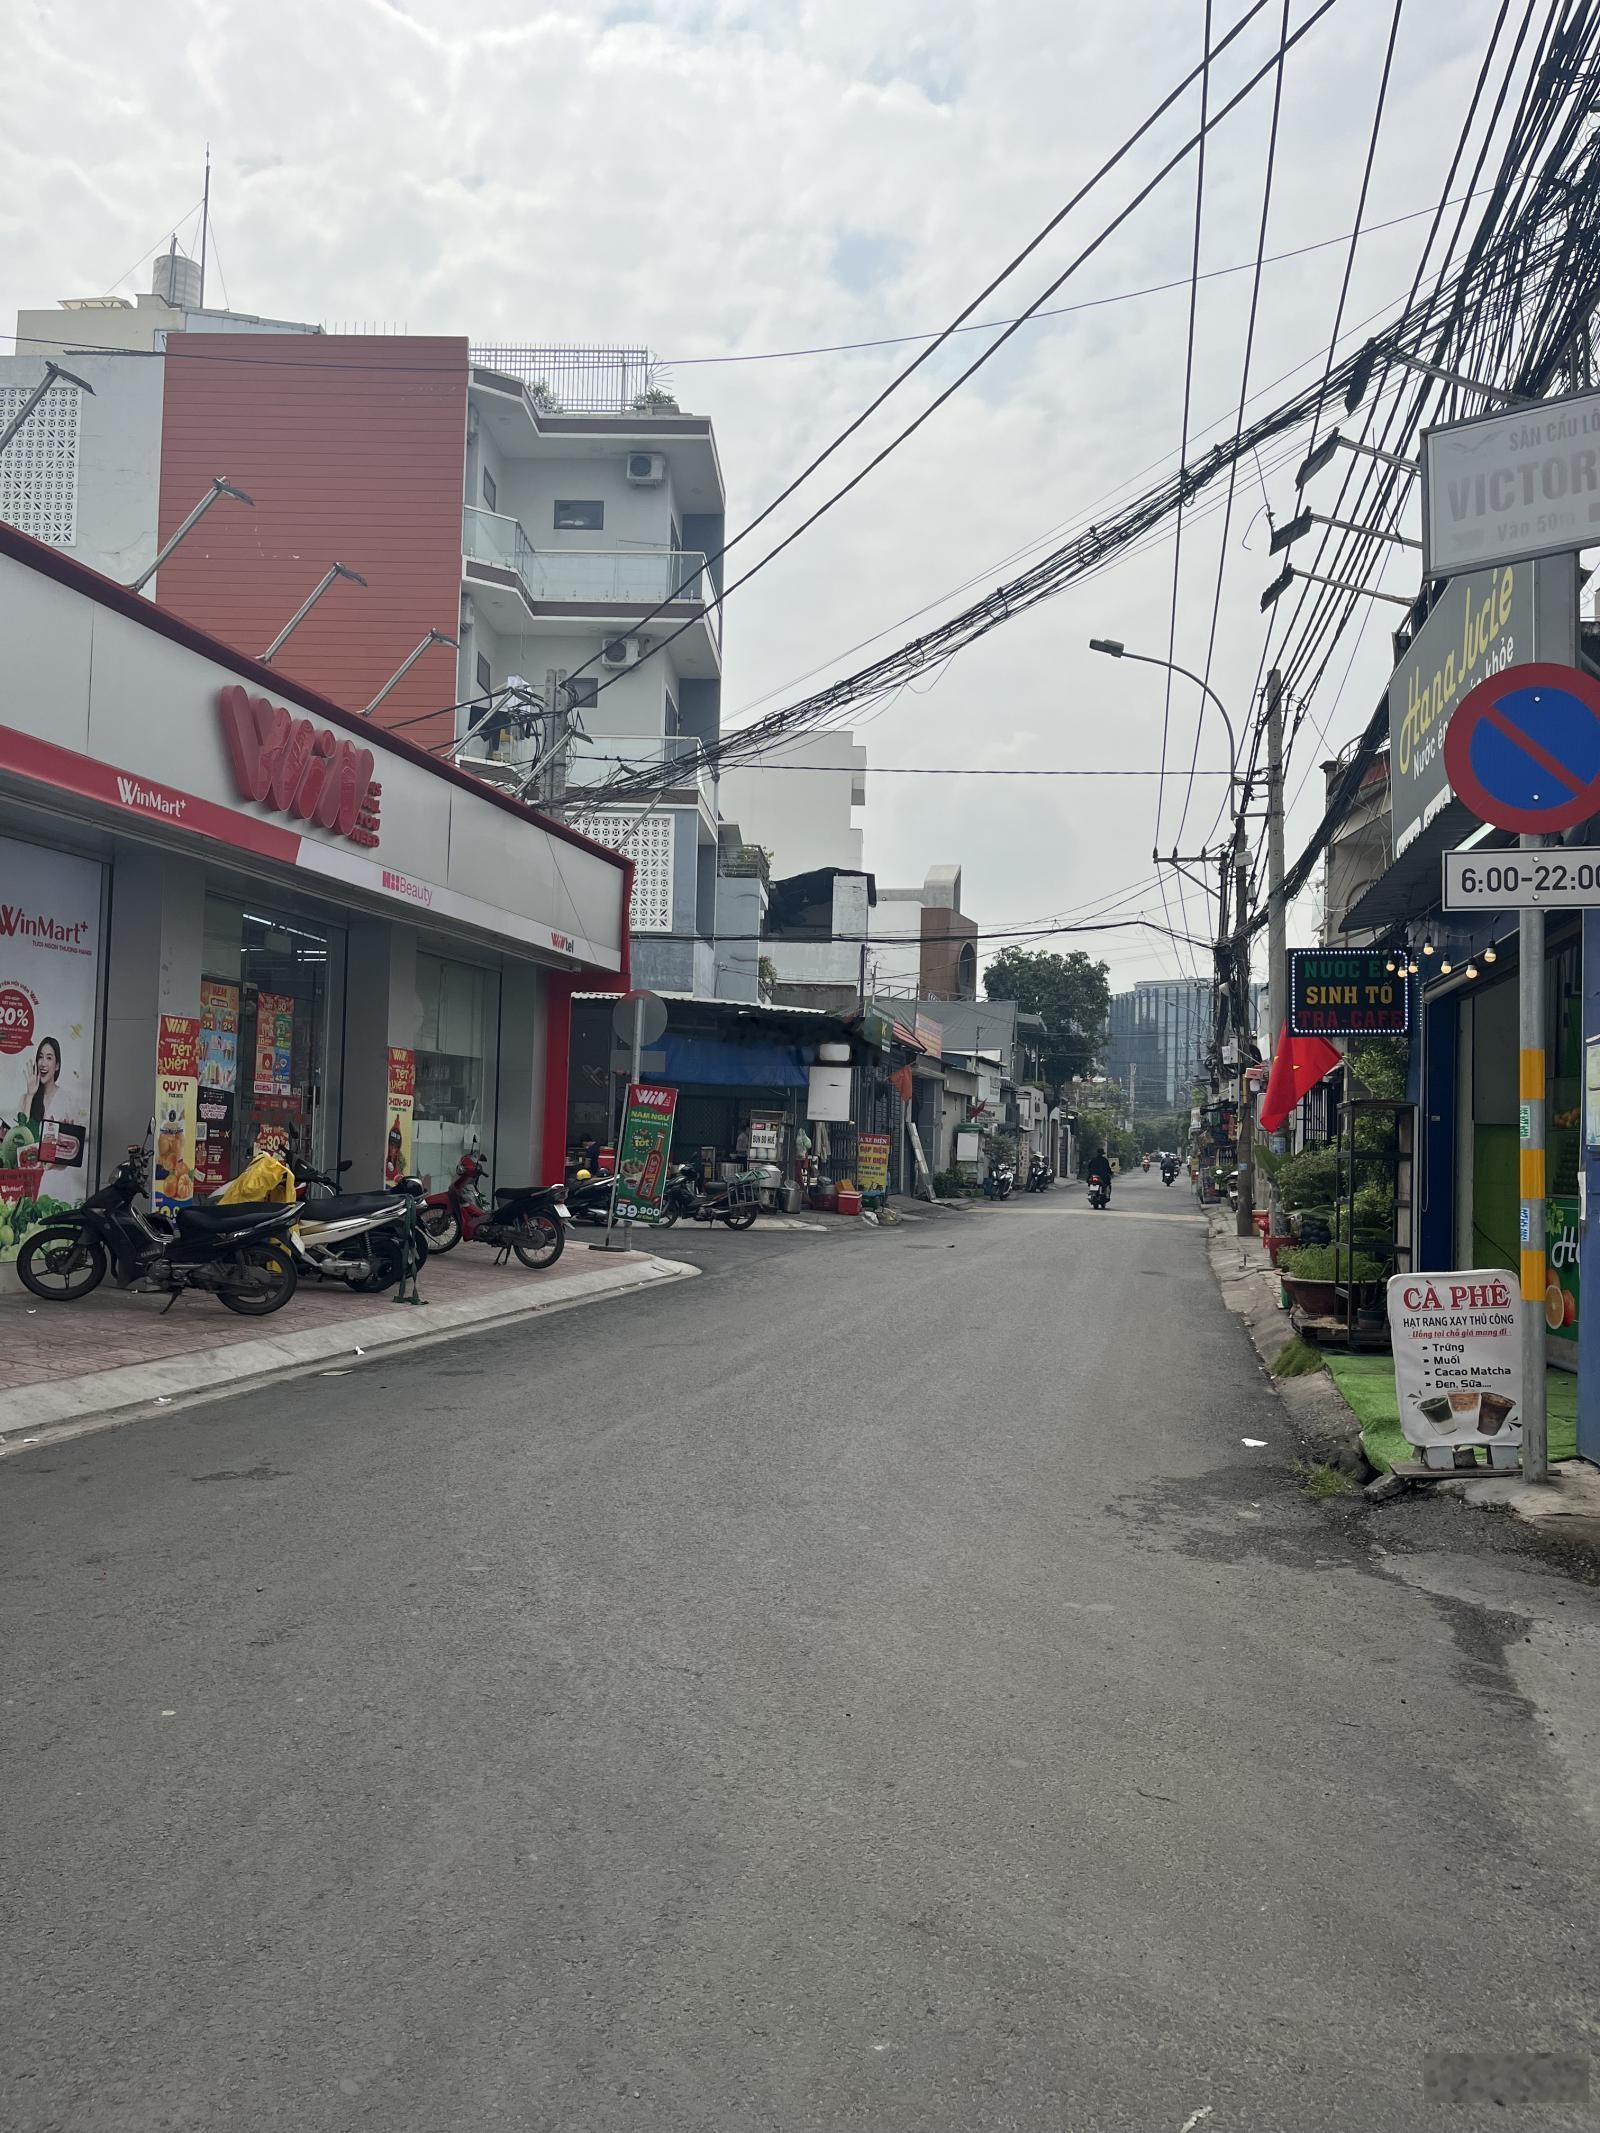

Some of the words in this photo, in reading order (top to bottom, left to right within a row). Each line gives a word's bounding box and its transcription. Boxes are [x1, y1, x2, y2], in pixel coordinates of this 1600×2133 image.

[1306, 985, 1357, 1004] SINH
[1403, 1280, 1444, 1311] CÀ
[1449, 1278, 1512, 1310] PHÊ
[1403, 1317, 1420, 1329] HẠT
[1423, 1317, 1447, 1327] RANG
[1450, 1316, 1468, 1326] XAY
[1470, 1313, 1487, 1325] THỦ
[1489, 1313, 1514, 1325] CÔNG
[1433, 1343, 1464, 1353] Trứng
[1434, 1354, 1460, 1365] Muối
[1435, 1368, 1468, 1376] Cacao
[1470, 1367, 1511, 1376] Matcha
